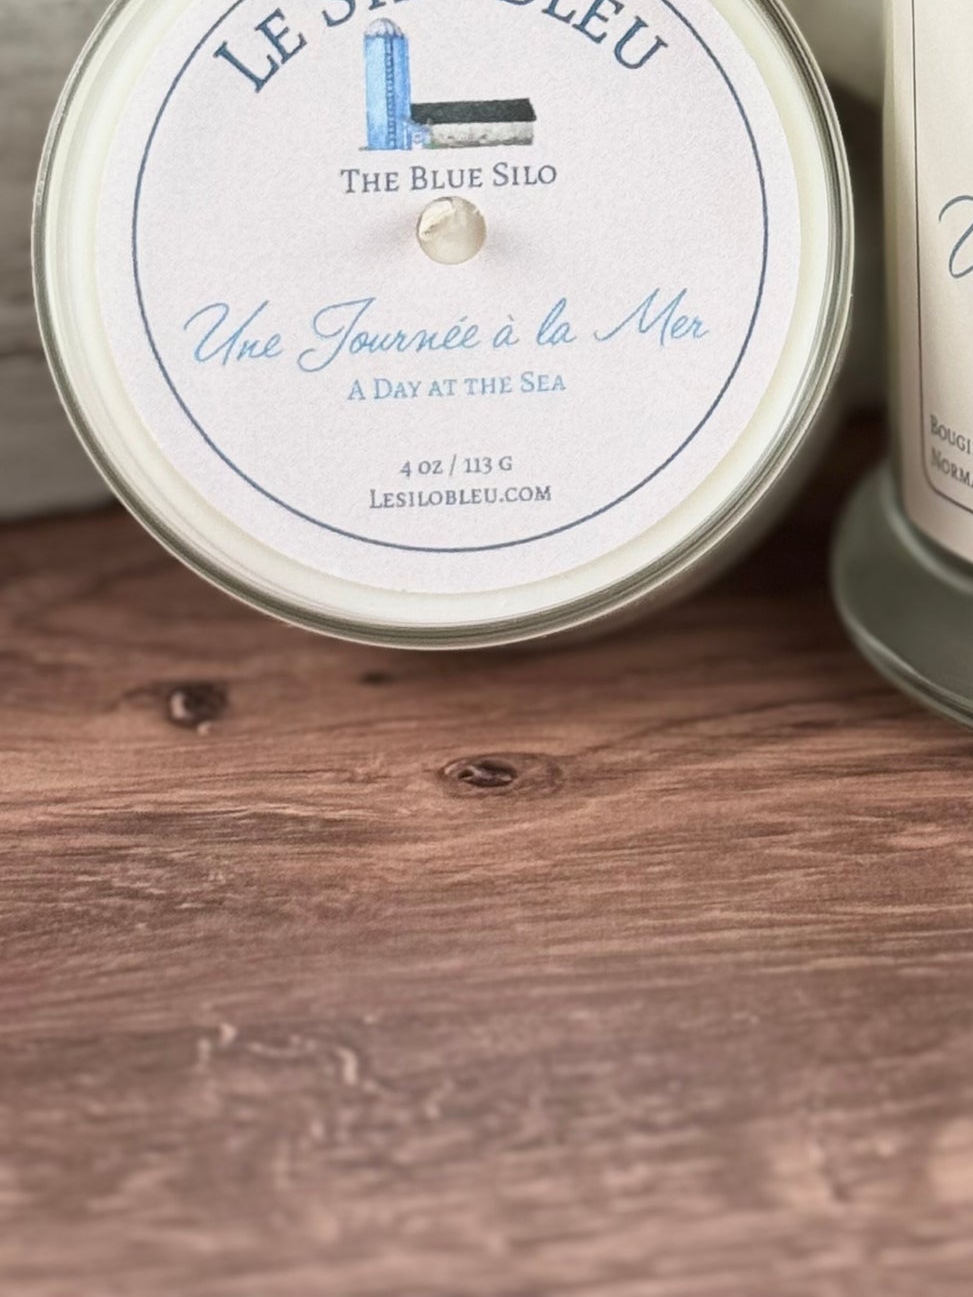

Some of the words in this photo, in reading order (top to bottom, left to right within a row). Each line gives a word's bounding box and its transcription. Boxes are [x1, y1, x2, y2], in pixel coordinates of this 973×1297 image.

[211, 5, 310, 95] LE
[339, 166, 401, 195] THE
[408, 165, 484, 192] BLUE
[491, 162, 558, 189] SILO
[181, 298, 284, 367] Une
[295, 295, 482, 374] Journée
[491, 312, 521, 349] à
[534, 295, 578, 347] la
[592, 286, 712, 344] Mer
[346, 378, 367, 402] A
[372, 376, 423, 401] DAY
[426, 378, 458, 399] AT
[462, 376, 513, 397] THE
[519, 370, 568, 395] SEA
[400, 460, 413, 479] 4
[417, 459, 444, 476] OZ
[463, 456, 494, 476] 113
[497, 455, 514, 472] G
[368, 483, 553, 510] LESILOBLEU.COM
